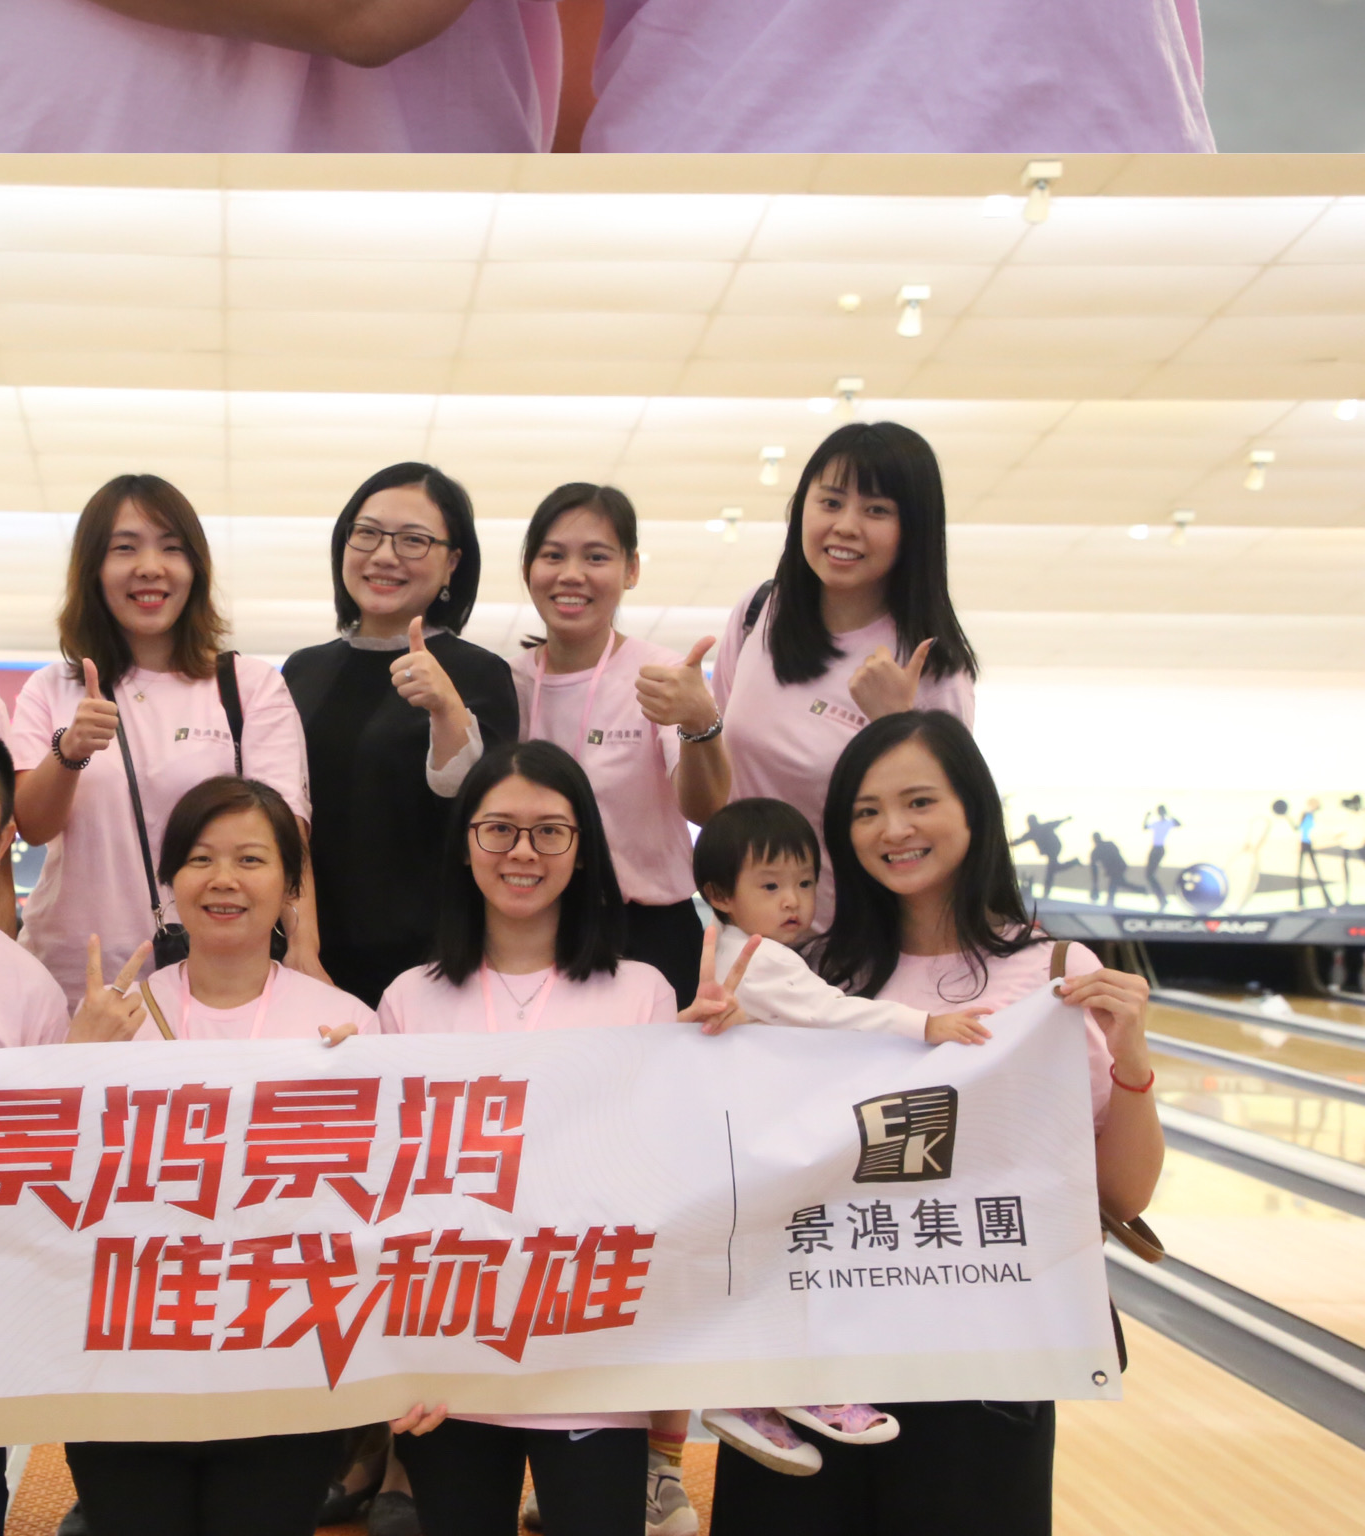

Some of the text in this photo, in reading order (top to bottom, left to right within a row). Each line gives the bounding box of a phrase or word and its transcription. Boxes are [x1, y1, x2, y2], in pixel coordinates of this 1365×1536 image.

[785, 1196, 1027, 1254] 景鴻集團
[789, 1262, 1032, 1291] EK INTERNATIONAL
[84, 1224, 658, 1391] 唯我称雄
